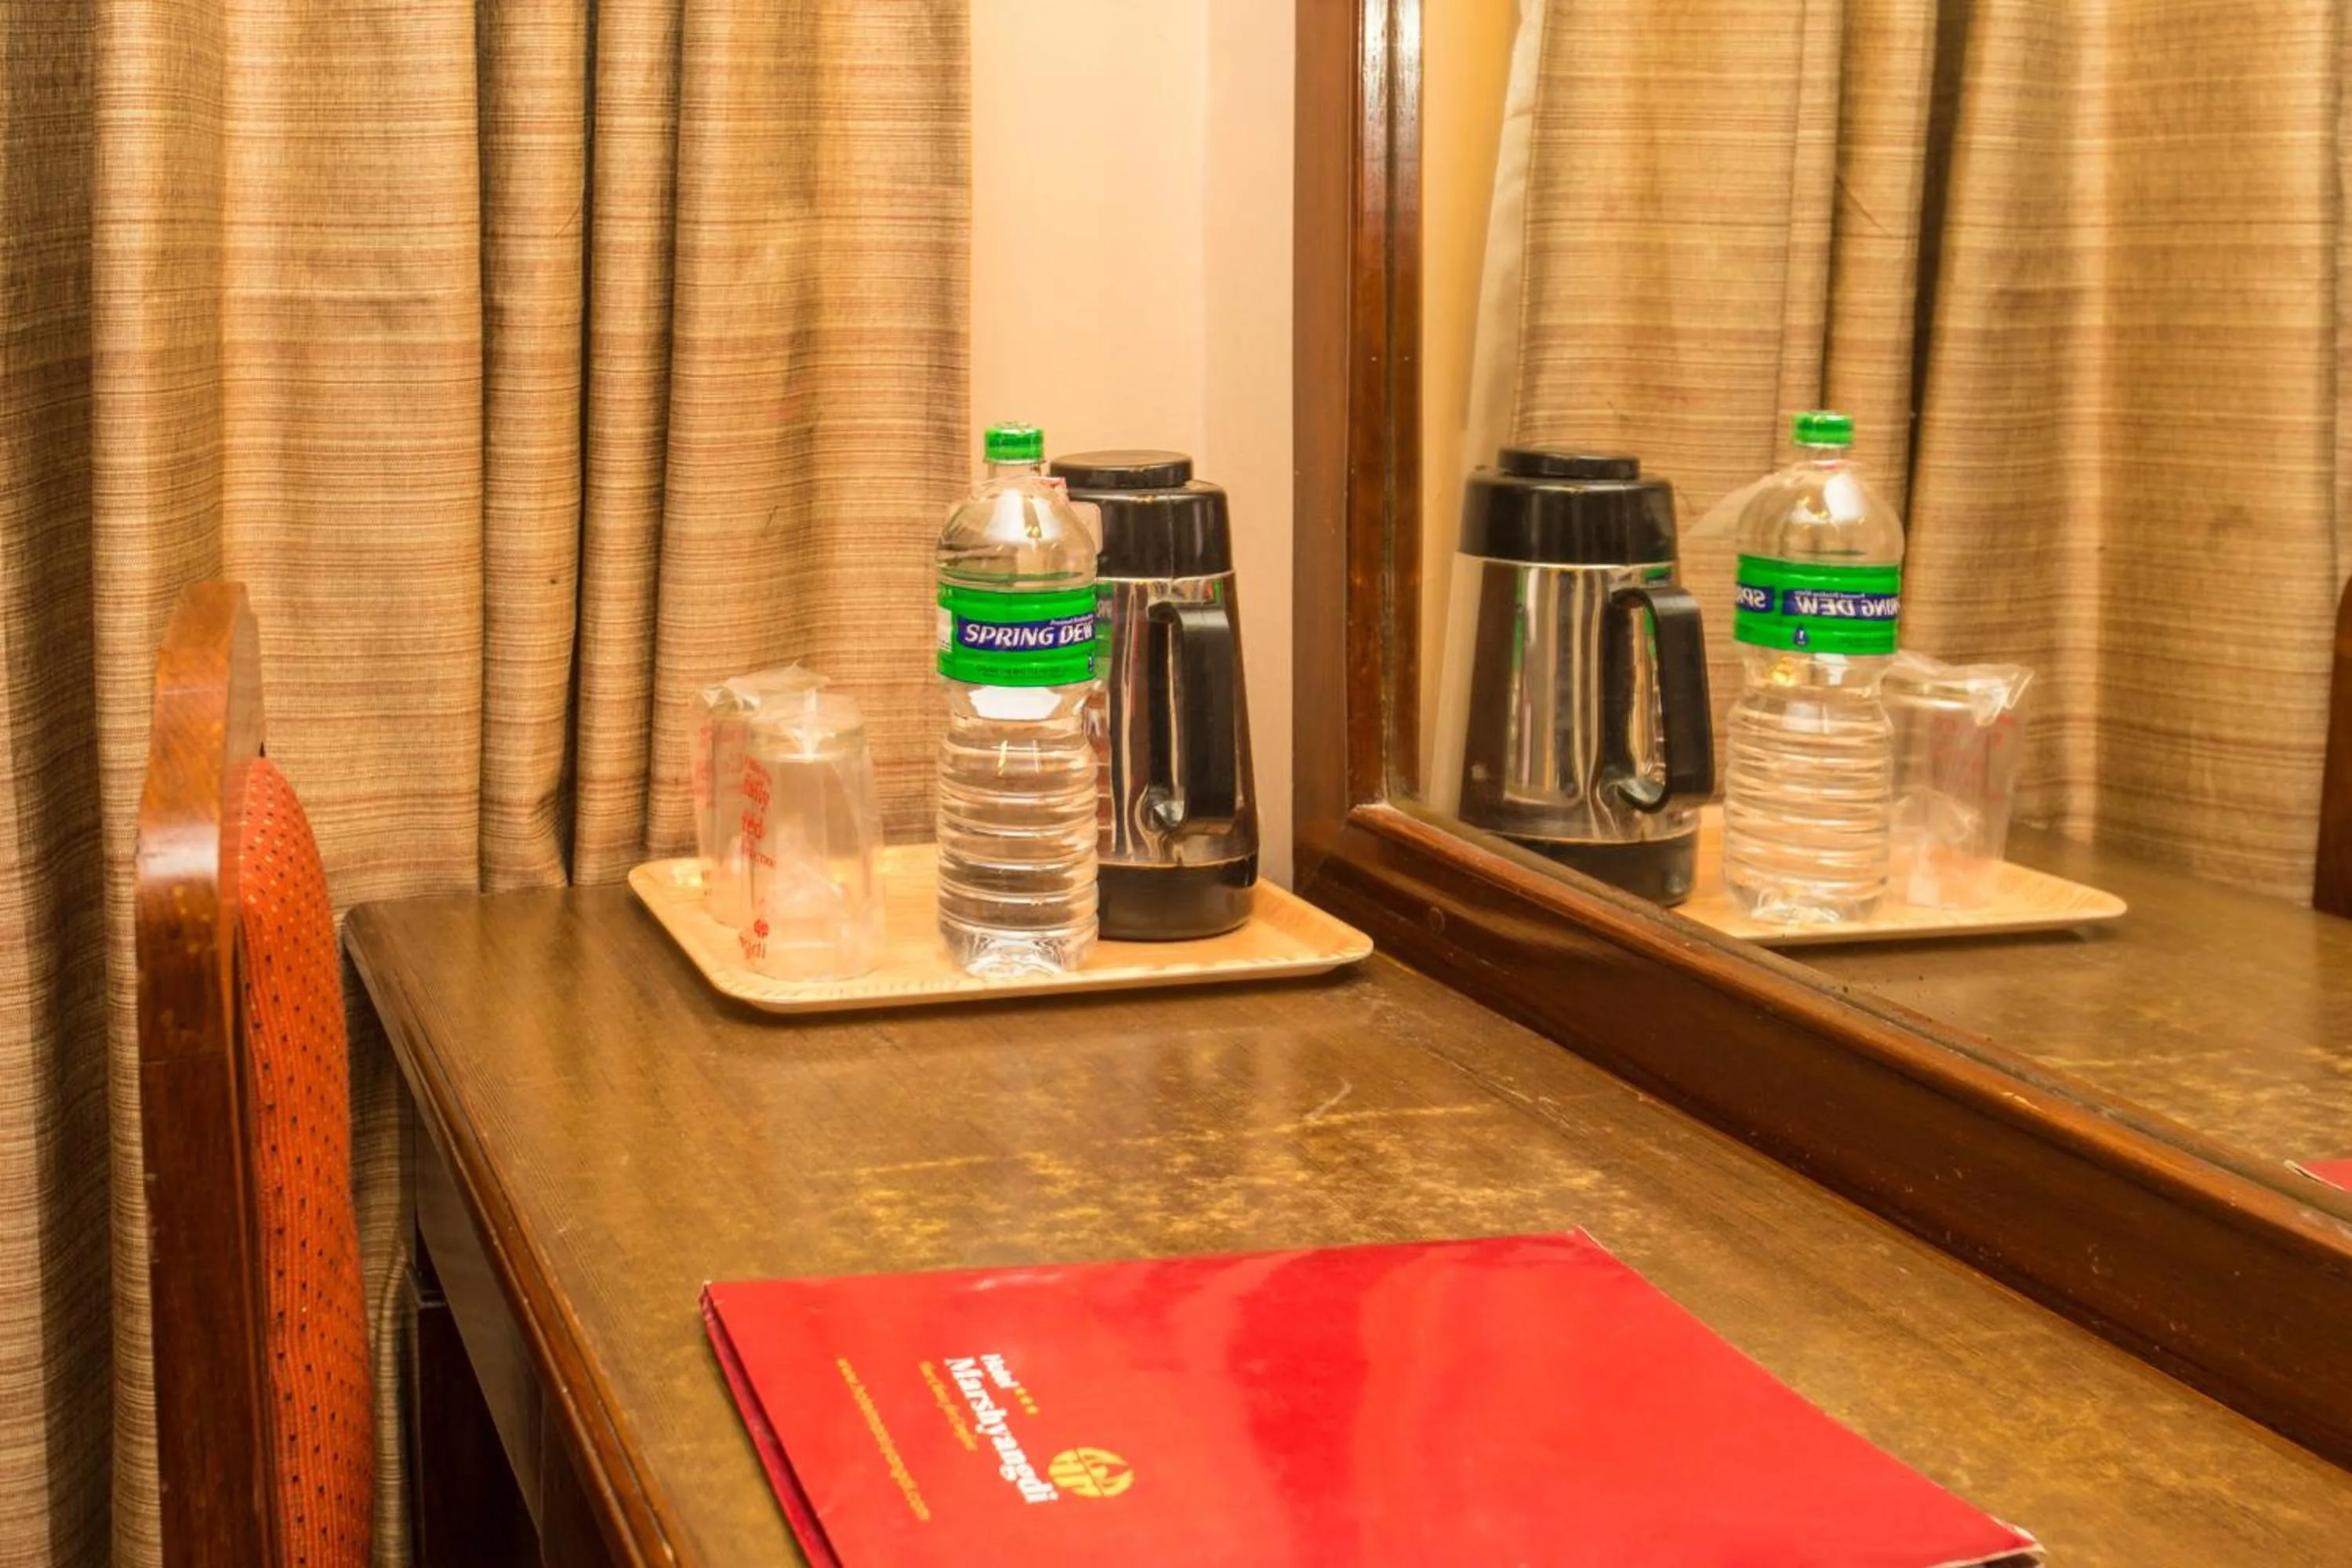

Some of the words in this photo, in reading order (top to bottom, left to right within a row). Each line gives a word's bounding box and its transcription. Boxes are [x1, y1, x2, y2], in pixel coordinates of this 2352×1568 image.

[964, 624, 1054, 647] SPRING
[1058, 622, 1092, 644] DEW
[944, 1357, 1059, 1504] Marshyangdi
